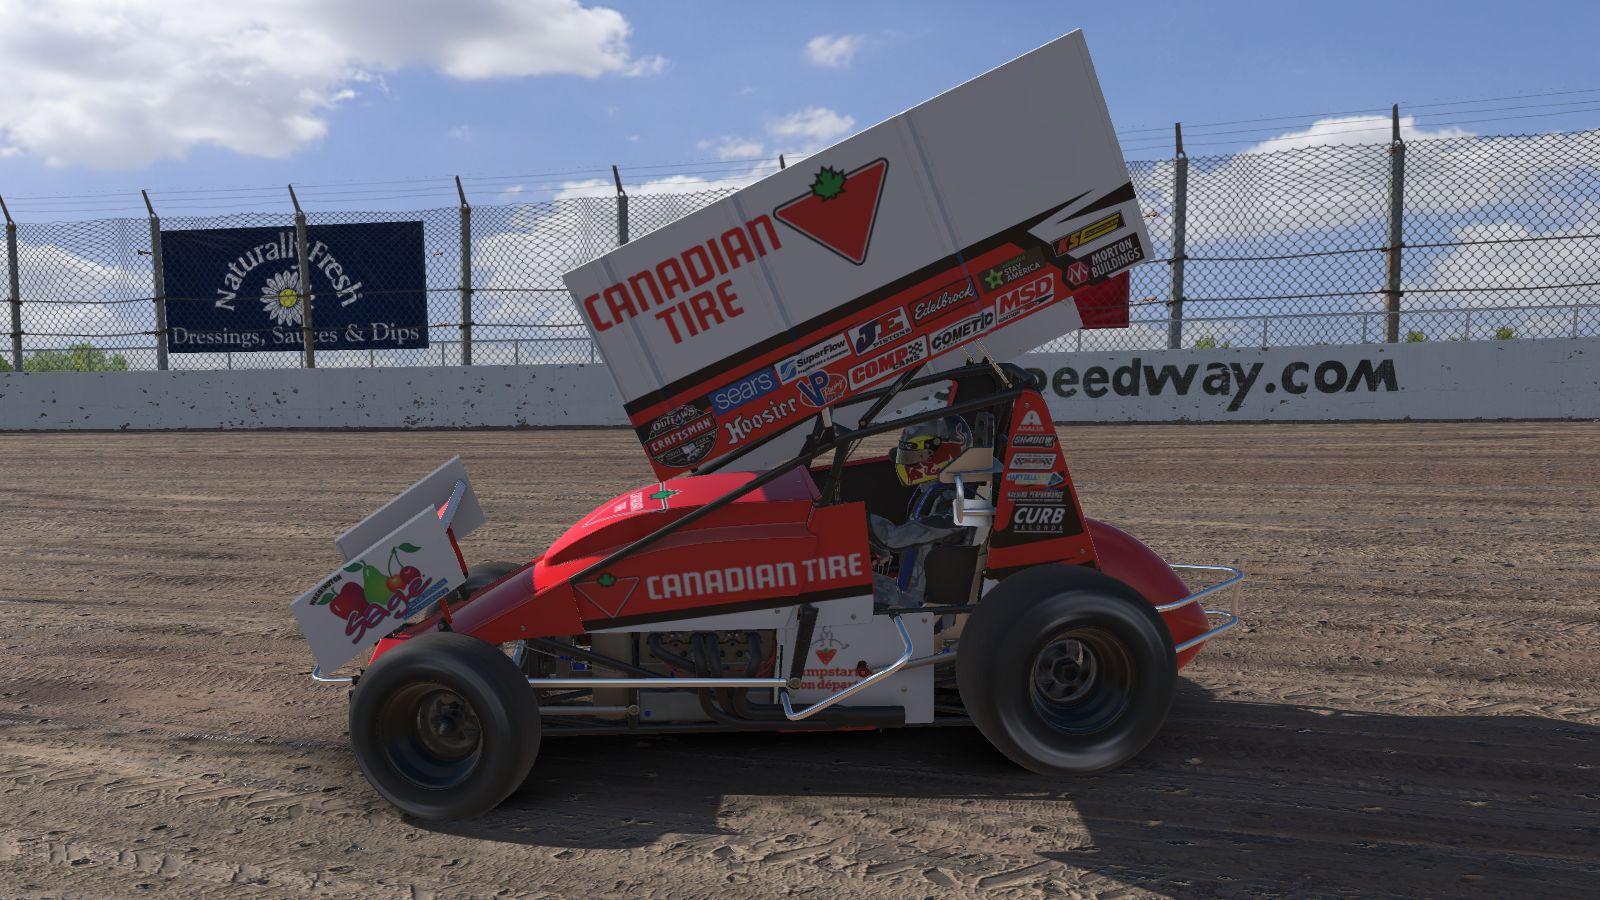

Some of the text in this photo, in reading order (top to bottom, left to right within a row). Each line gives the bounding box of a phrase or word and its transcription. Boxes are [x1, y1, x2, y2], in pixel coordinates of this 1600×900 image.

[1003, 262, 1022, 276] STAY
[1091, 238, 1133, 266] MORTON
[1091, 247, 1141, 278] BUILDINGS
[308, 240, 364, 308] Fresh
[583, 214, 783, 332] CANADIAN
[1006, 262, 1041, 282] AMERICA
[655, 280, 745, 344] TIRE
[914, 283, 975, 320] Edelbrock
[1000, 277, 1054, 315] MSD
[172, 322, 419, 348] Dressings, Saues & Dips
[931, 311, 994, 350] COMETIC
[796, 339, 846, 370] SuperFlow
[852, 347, 909, 385] COMP
[715, 374, 773, 410] sears
[796, 369, 830, 407] VP
[651, 418, 712, 452] CRAFTSMAN
[724, 398, 797, 445] Hoosier
[1013, 507, 1066, 524] CURB
[646, 552, 863, 600] CANADIAN TIRE
